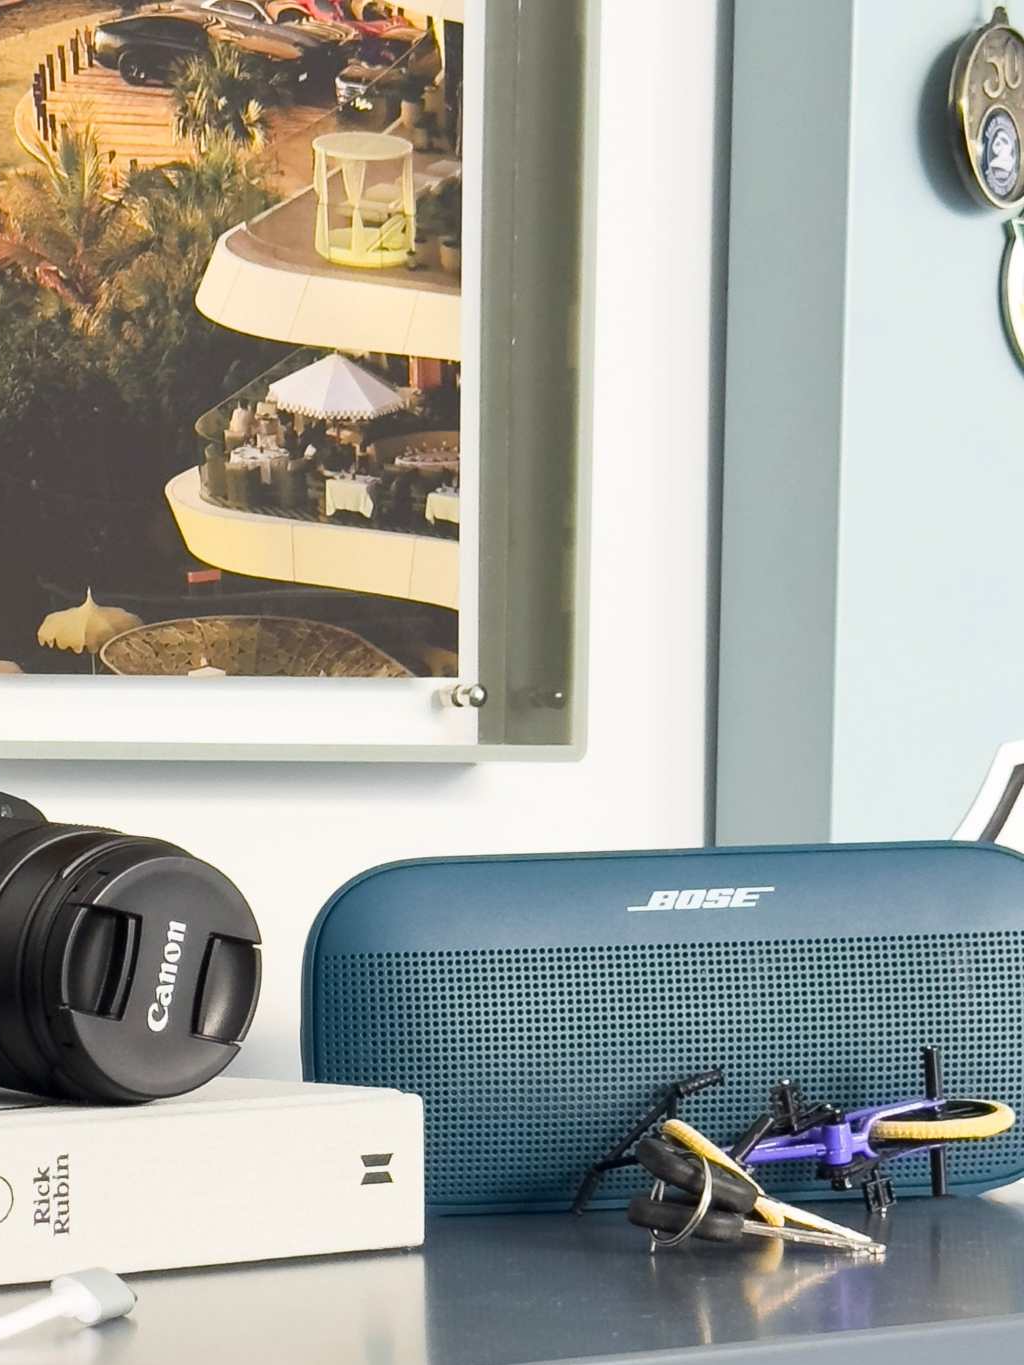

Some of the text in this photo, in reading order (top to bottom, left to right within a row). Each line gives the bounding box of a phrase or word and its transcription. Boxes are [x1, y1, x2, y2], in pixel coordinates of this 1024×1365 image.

[626, 885, 775, 912] BOSE
[147, 920, 186, 1032] Canon
[33, 1166, 51, 1226] Rick
[52, 1153, 70, 1237] Rubin
